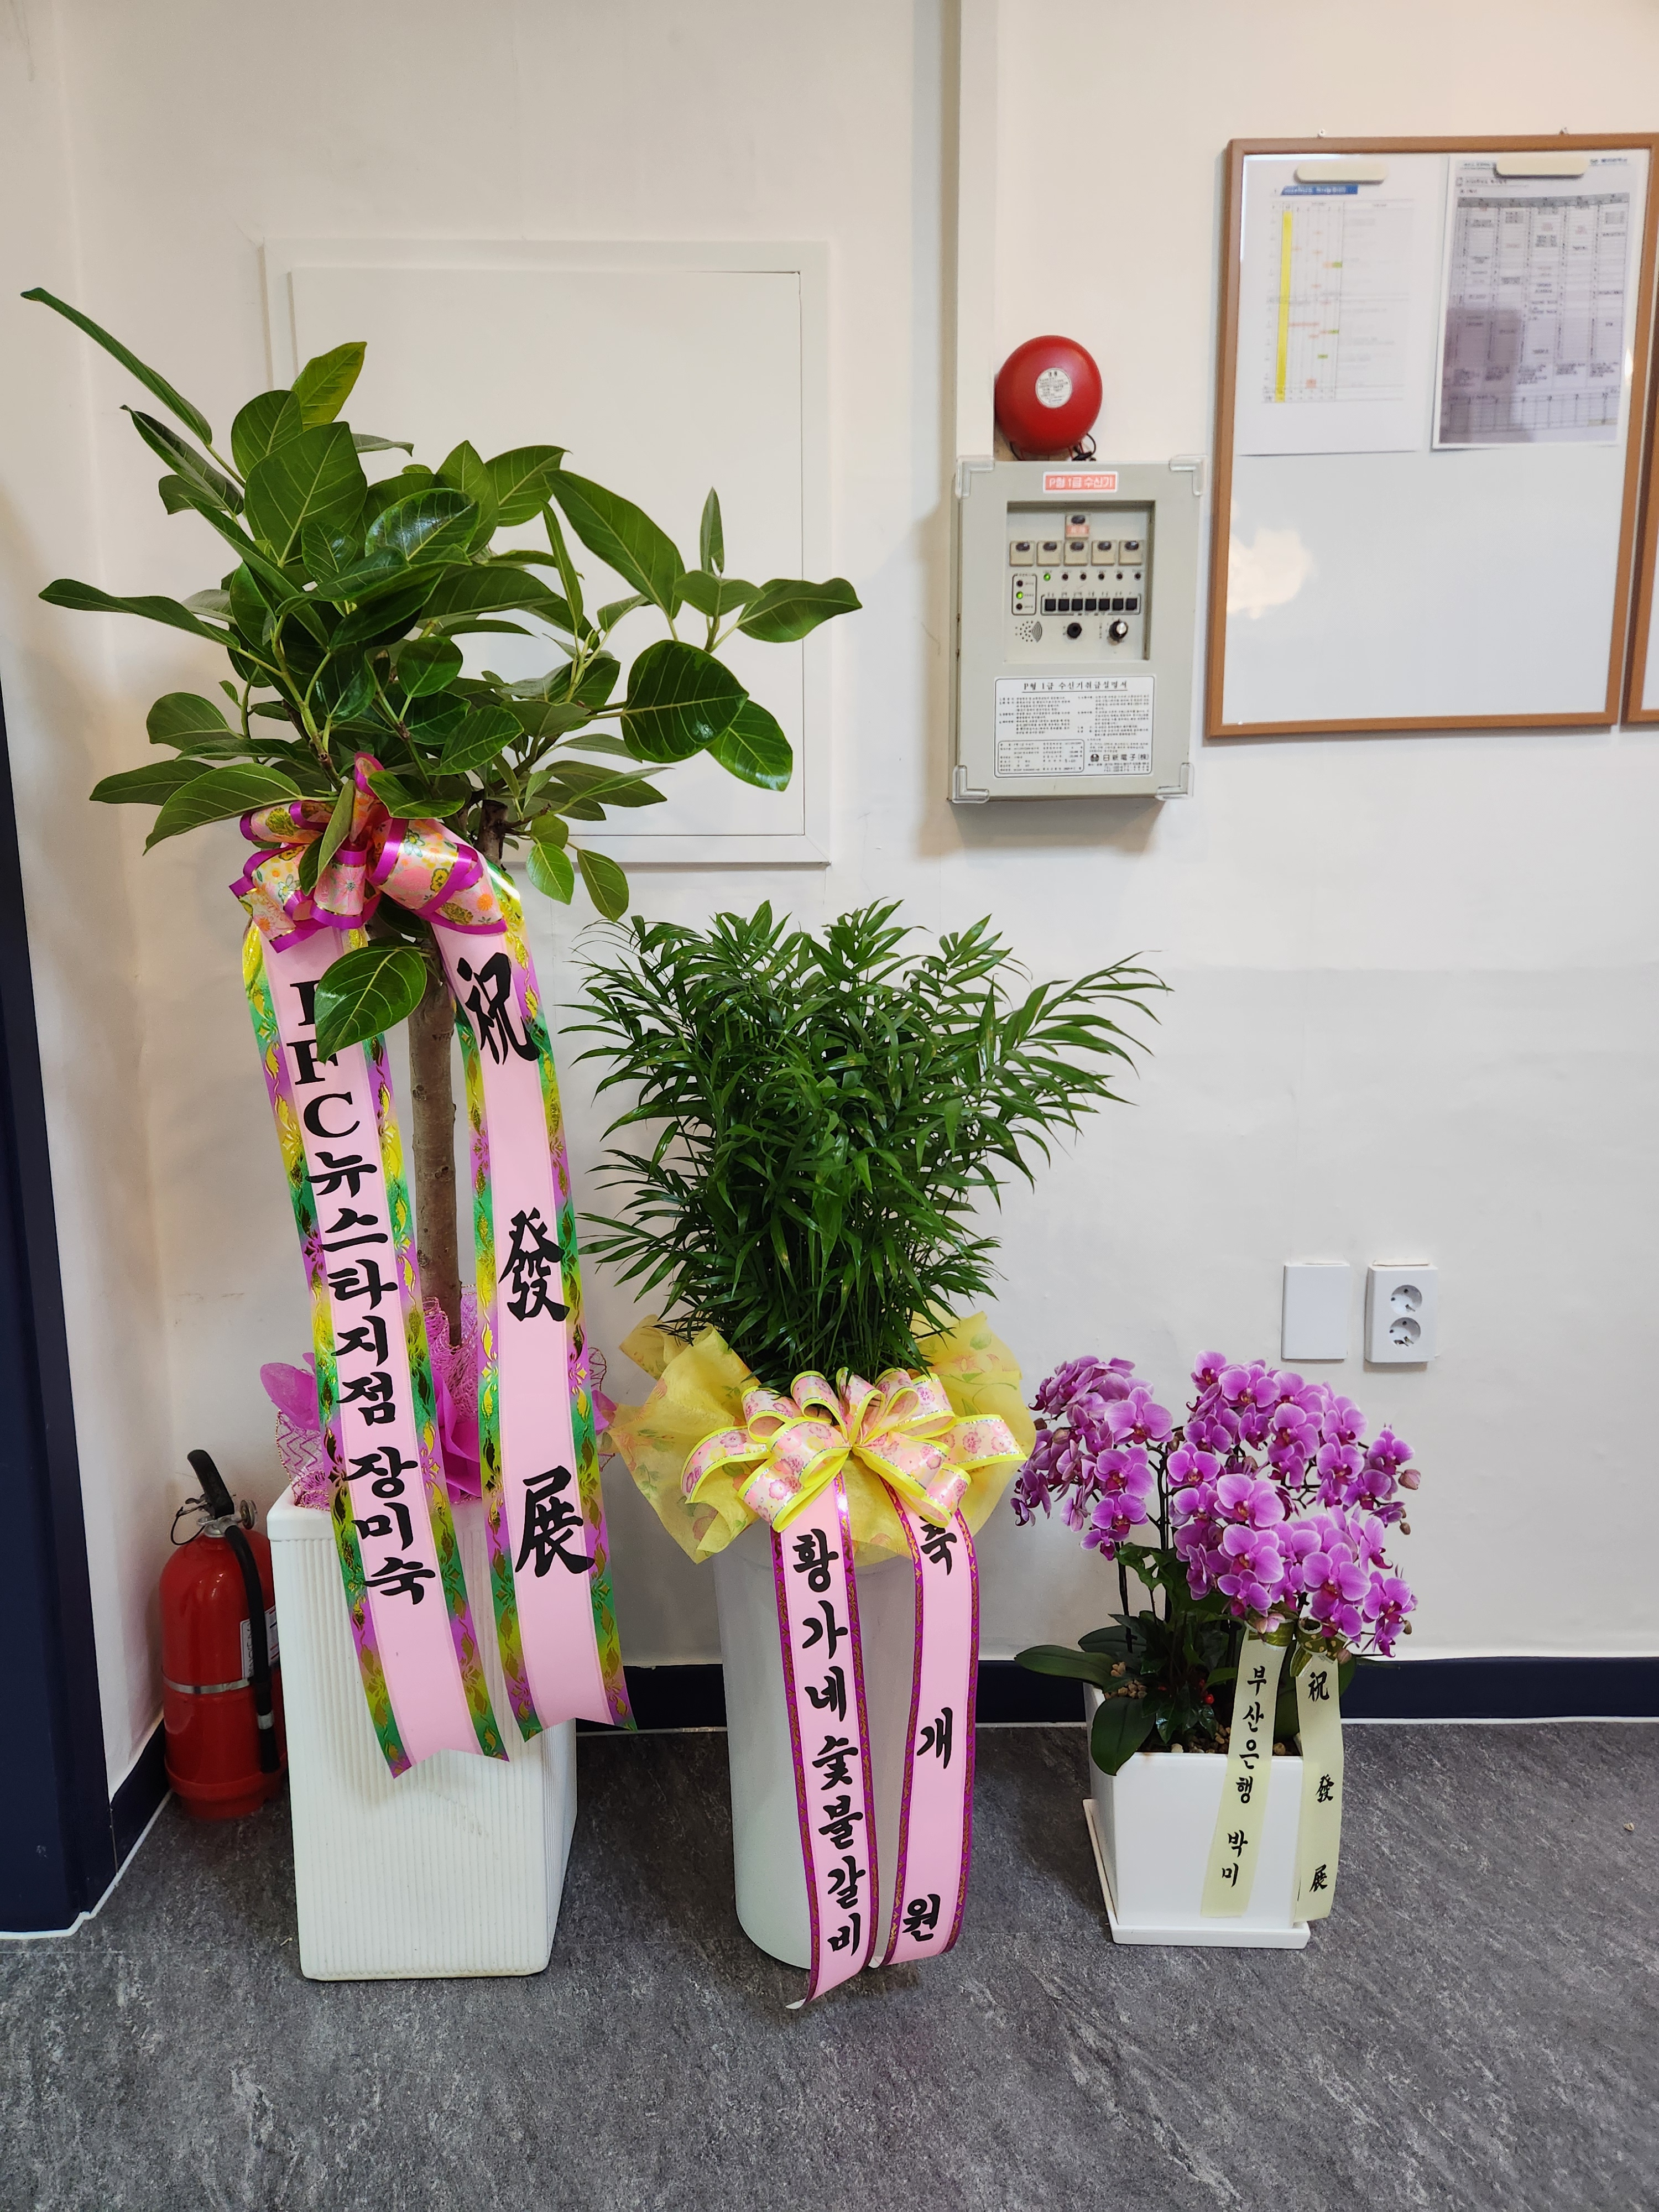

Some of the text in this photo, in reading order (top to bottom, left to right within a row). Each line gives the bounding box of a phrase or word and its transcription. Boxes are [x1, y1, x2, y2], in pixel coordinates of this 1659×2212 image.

[1084, 477, 1113, 489] 수신기
[348, 1447, 436, 1605] 장미숙
[1236, 1665, 1267, 1804] 부산은행
